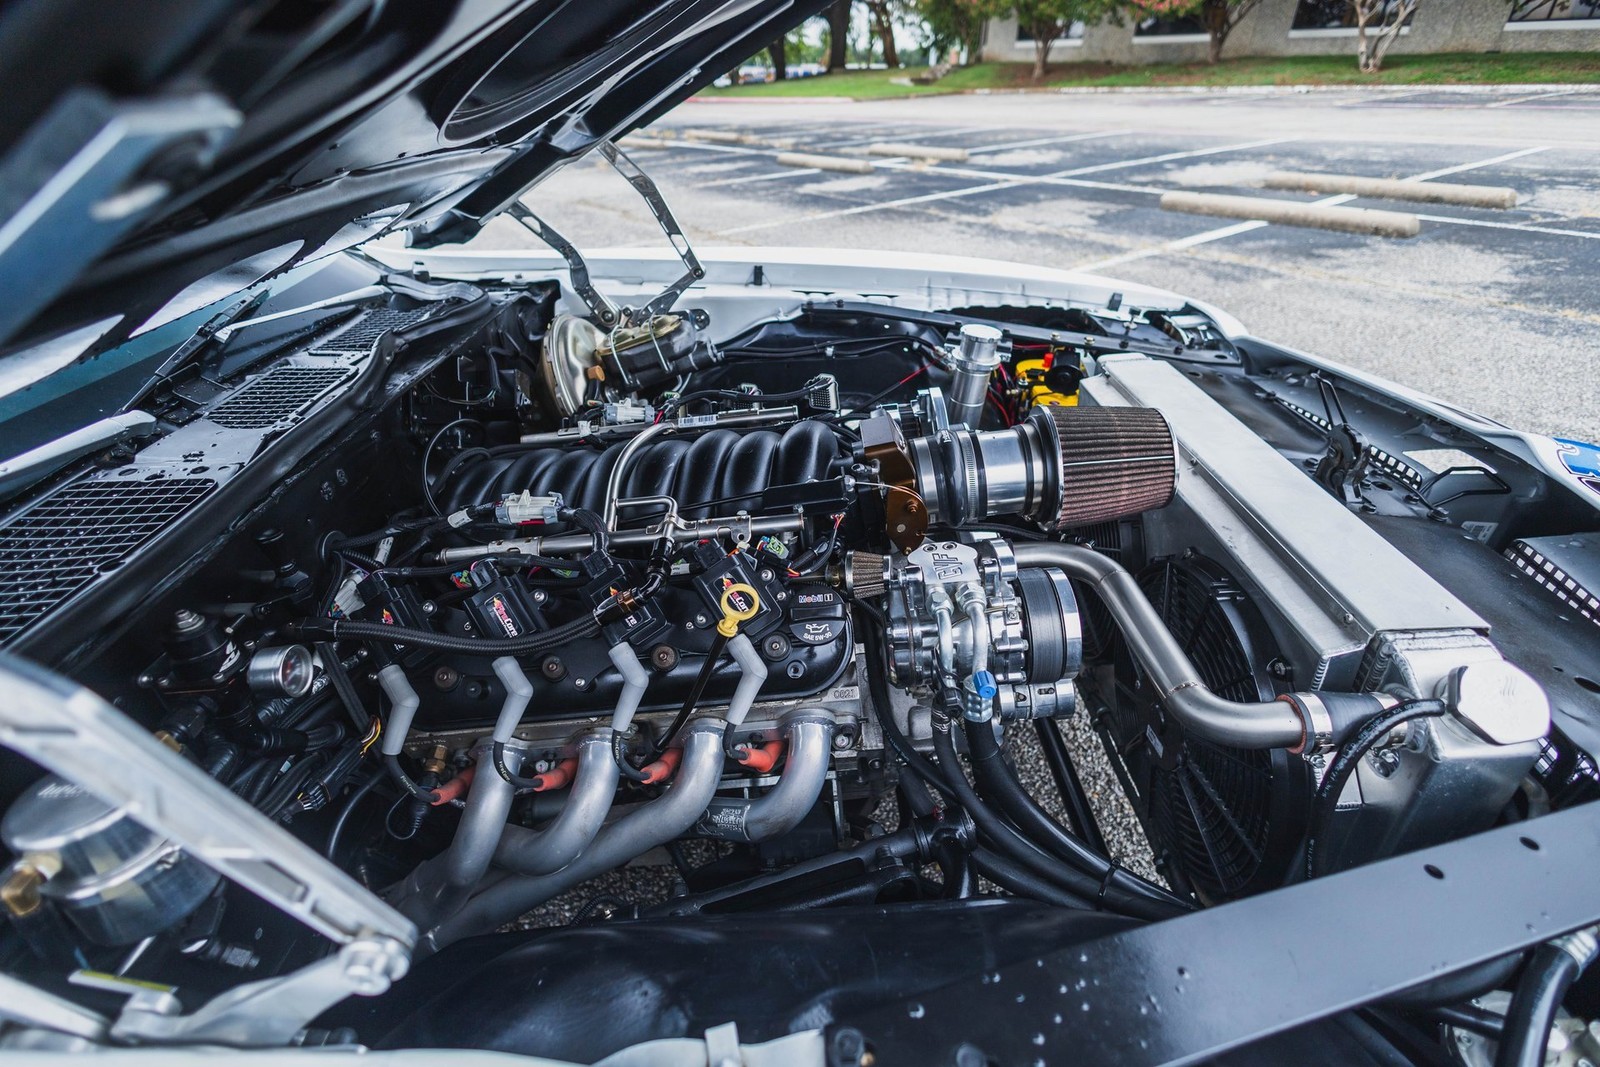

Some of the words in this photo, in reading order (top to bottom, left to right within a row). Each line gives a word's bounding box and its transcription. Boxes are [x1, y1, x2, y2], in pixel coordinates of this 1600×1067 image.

[931, 553, 963, 580] CVF
[799, 594, 823, 603] Mobil
[803, 632, 815, 640] SAE
